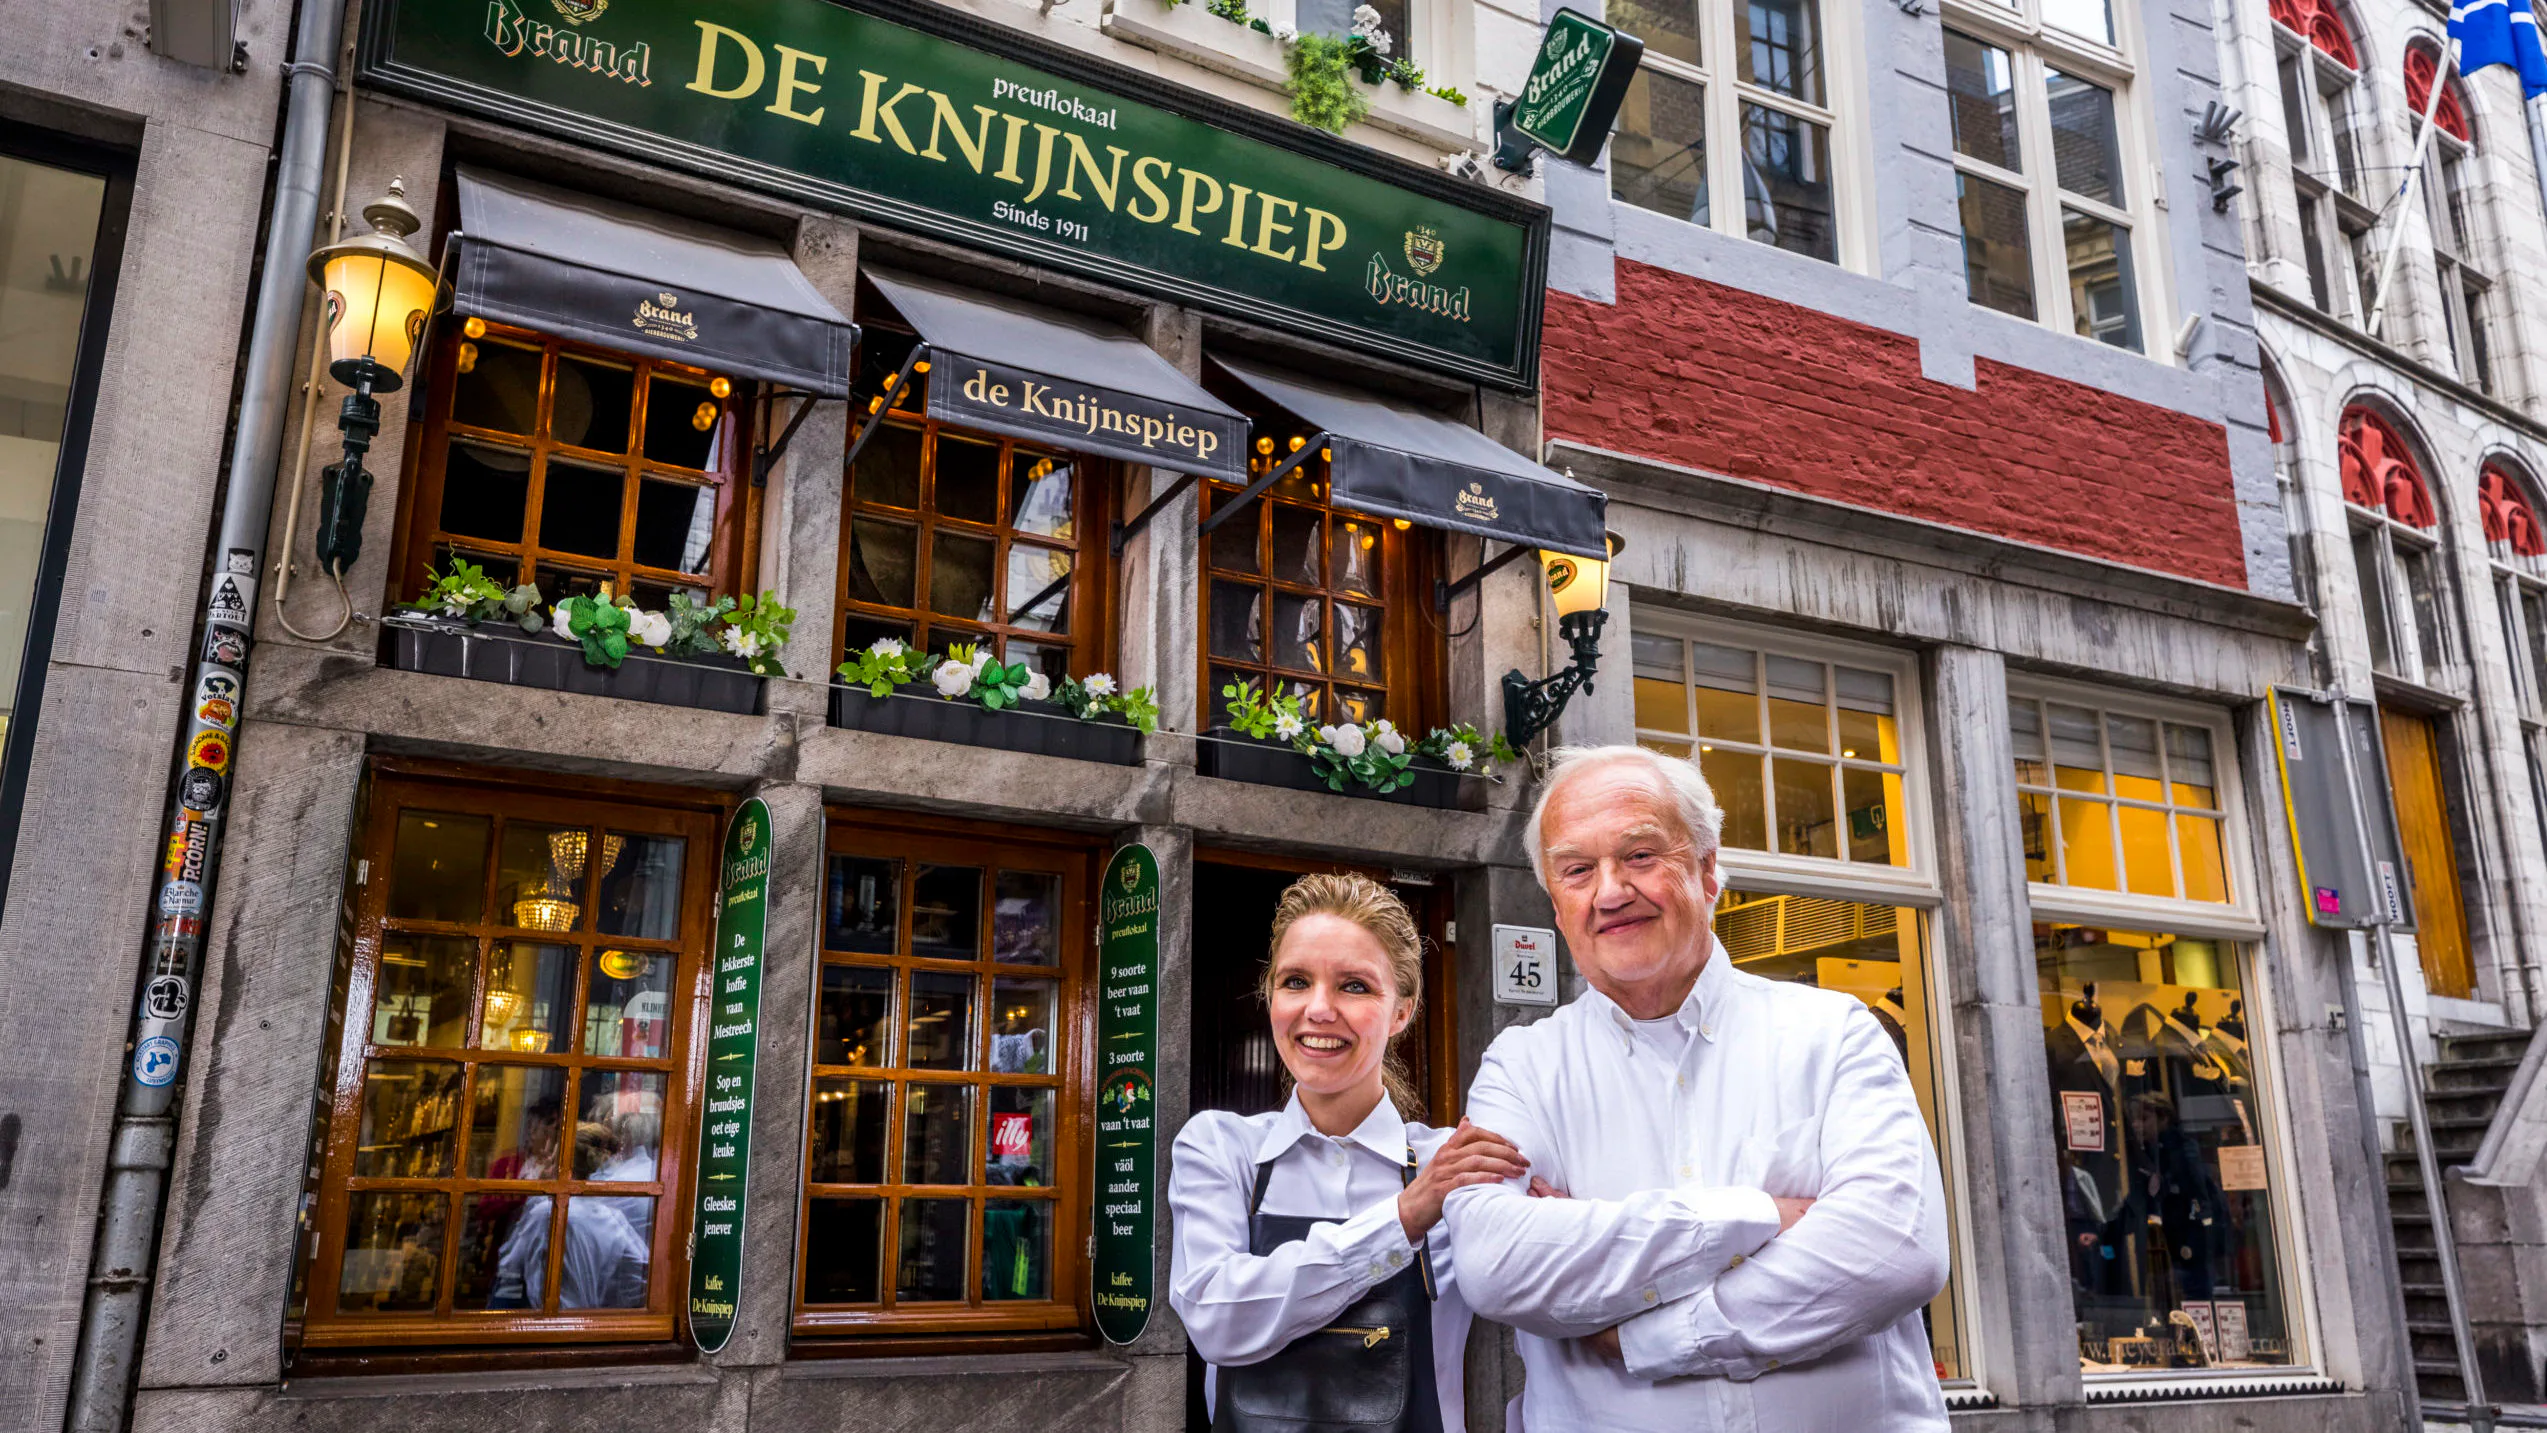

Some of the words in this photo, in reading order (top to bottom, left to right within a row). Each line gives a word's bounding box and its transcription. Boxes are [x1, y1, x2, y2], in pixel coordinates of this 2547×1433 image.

[484, 0, 652, 87] Brand
[1528, 32, 1590, 103] Brand
[1550, 85, 1568, 103] 1340
[993, 77, 1117, 130] preuflokaal
[685, 20, 828, 126] DE
[850, 69, 1347, 272] KNIJNSPIEP
[993, 201, 1050, 231] Sinds
[1056, 217, 1088, 242] 1911
[1417, 225, 1437, 236] 1340
[1365, 251, 1471, 322] Brand
[640, 299, 694, 326] Brand
[963, 369, 1009, 407] de
[1020, 380, 1218, 460] Knijnspiep
[1459, 489, 1494, 508] Brand
[725, 847, 767, 890] Brand
[1104, 887, 1156, 924] Brand
[734, 933, 745, 948] De
[1515, 940, 1536, 951] Duvel
[721, 953, 754, 973] lekkerste
[1111, 967, 1117, 979] 9
[1118, 963, 1146, 977] soorte
[1509, 960, 1541, 988] 45
[726, 978, 747, 994] koffie
[1107, 985, 1126, 999] beer
[1128, 984, 1149, 997] vaan
[726, 1002, 743, 1016] vaan
[1122, 1003, 1141, 1016] vaat
[714, 1019, 752, 1040] Mestreech
[1109, 1052, 1115, 1065] 3
[1116, 1050, 1145, 1064] soorte
[717, 1074, 730, 1092] Sop
[731, 1077, 741, 1087] en
[709, 1095, 745, 1113] bruudsjes
[711, 1121, 722, 1135] oet
[724, 1119, 740, 1139] eige
[1100, 1119, 1122, 1132] vaan
[1131, 1115, 1150, 1129] vaat
[995, 1119, 1030, 1151] illy
[713, 1142, 735, 1158] keuke
[1115, 1158, 1134, 1173] väöl
[1109, 1179, 1139, 1193] aander
[704, 1195, 736, 1212] Gleeskes
[1105, 1199, 1141, 1221] speciaal
[704, 1222, 732, 1239] jenever
[1113, 1222, 1133, 1236] beer
[705, 1275, 723, 1291] kaffee
[1111, 1272, 1133, 1286] kaffee
[693, 1298, 701, 1313] De
[701, 1298, 733, 1320] Knijnspiep
[1098, 1292, 1108, 1306] De
[1109, 1291, 1147, 1312] Knijnspiep
